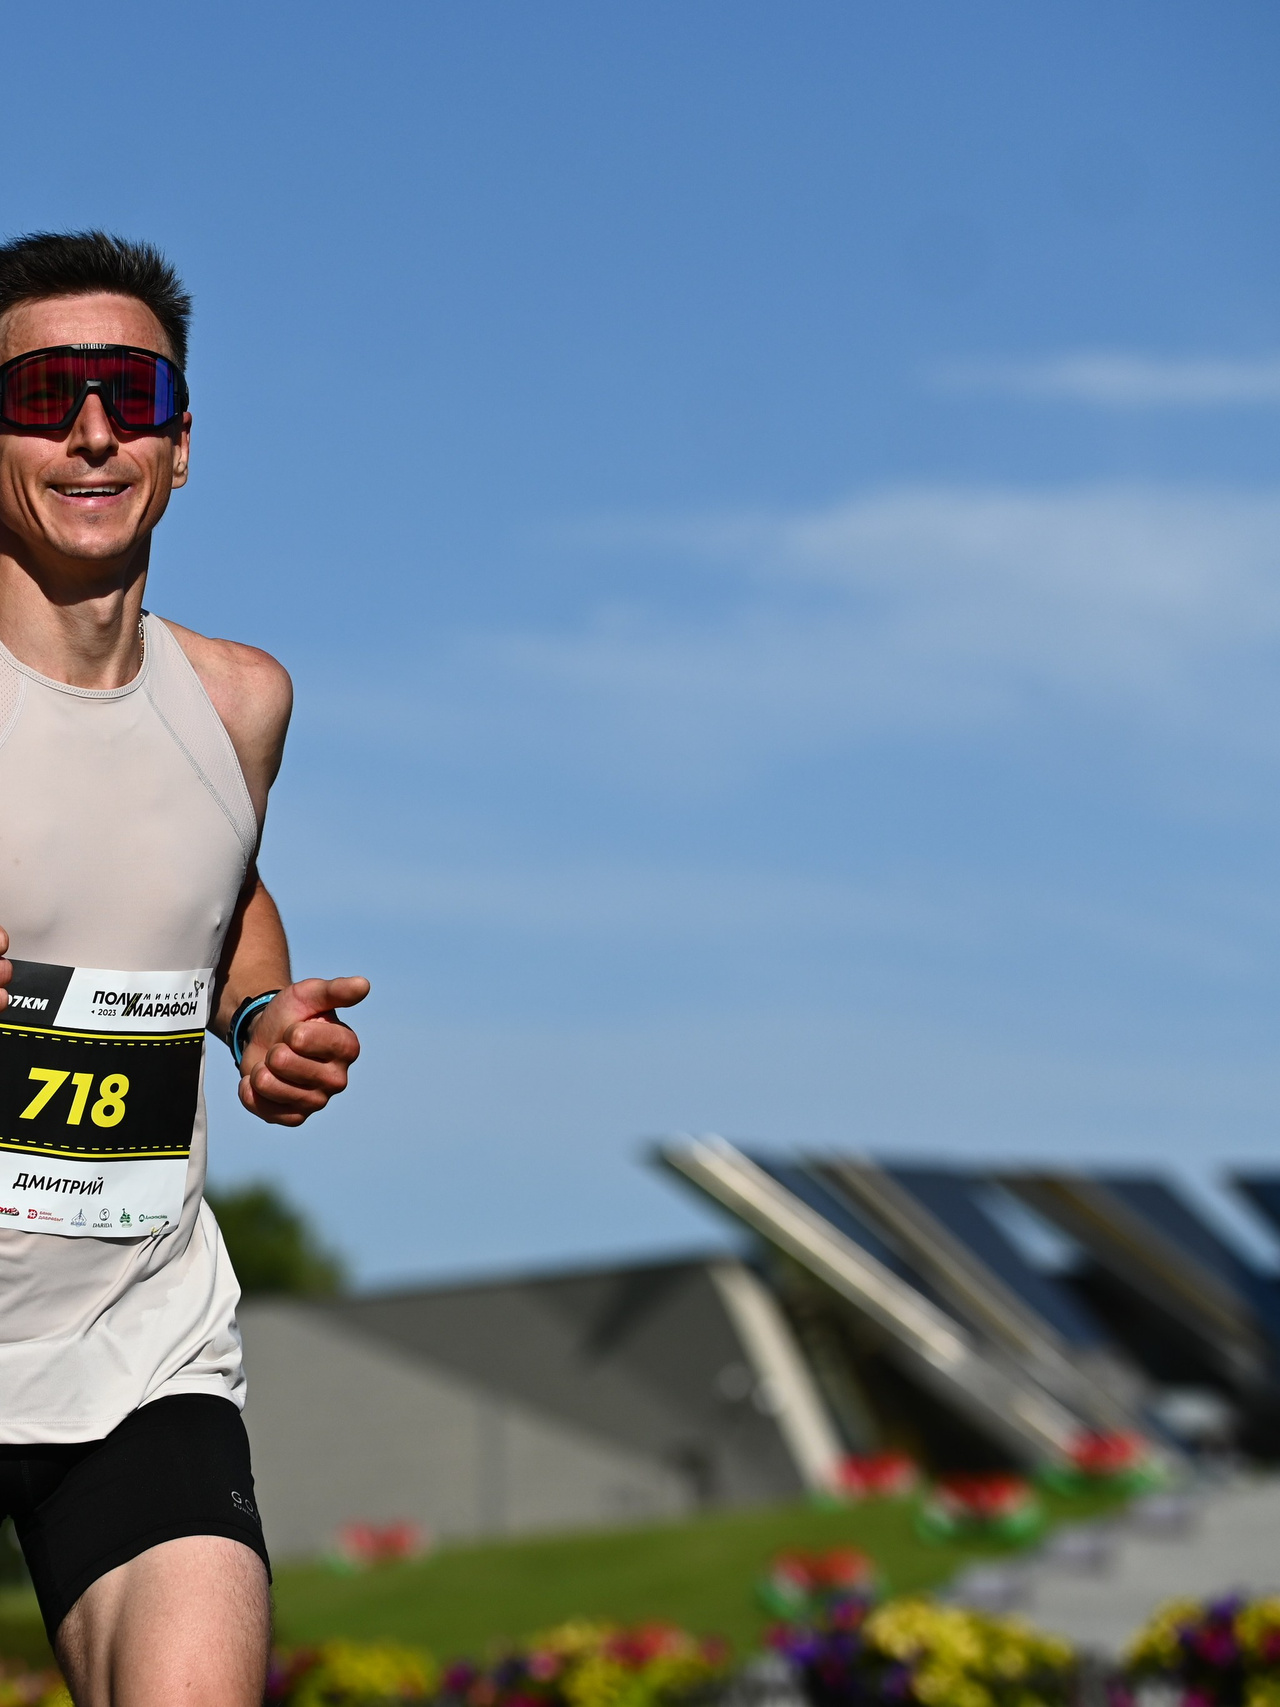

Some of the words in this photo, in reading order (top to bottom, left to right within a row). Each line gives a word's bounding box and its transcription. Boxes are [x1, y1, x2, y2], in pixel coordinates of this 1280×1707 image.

[97, 1008, 117, 1017] 2023
[125, 1001, 198, 1017] МАРАФОН
[19, 1068, 130, 1128] 718
[12, 1172, 104, 1196] ДМИТРИЙ
